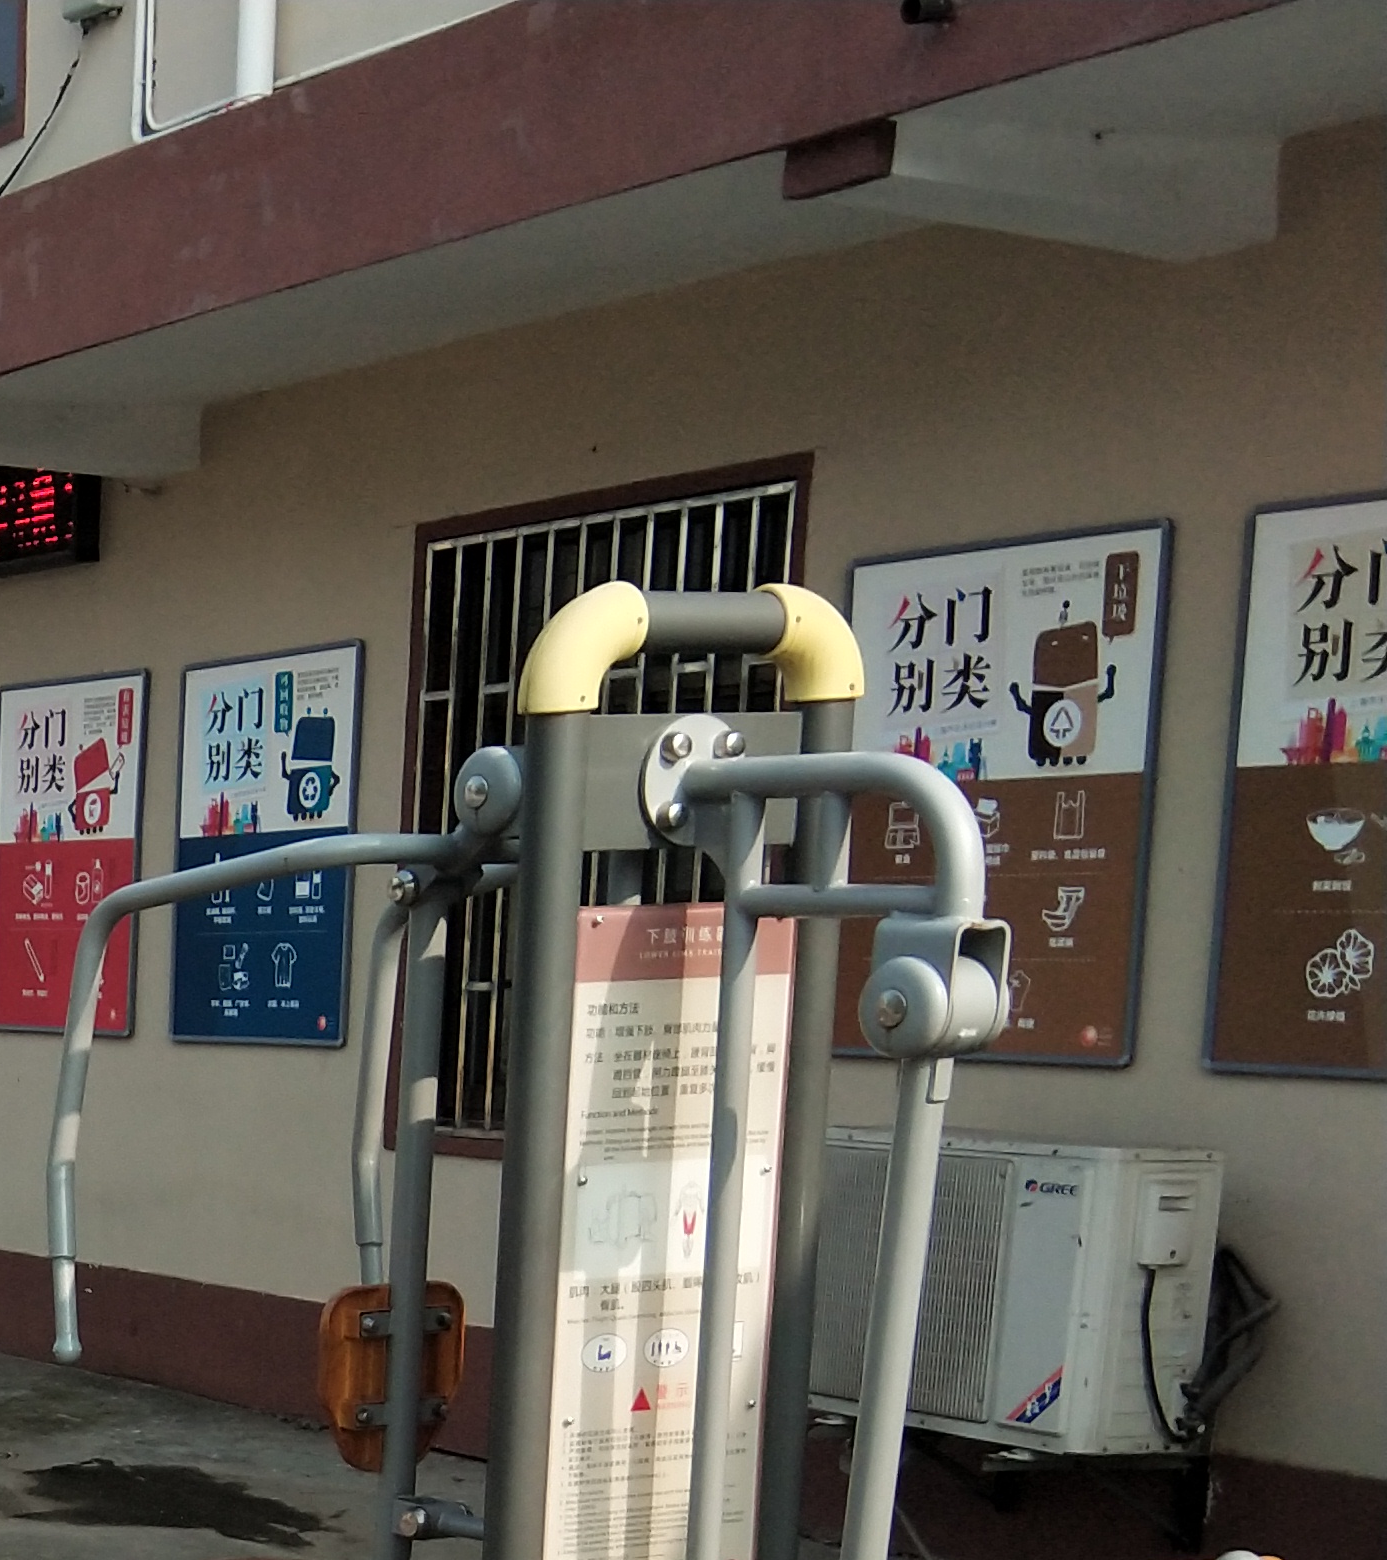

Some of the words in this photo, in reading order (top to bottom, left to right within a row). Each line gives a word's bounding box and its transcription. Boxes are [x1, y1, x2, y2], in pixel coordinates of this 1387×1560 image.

[889, 586, 992, 653] 分门
[888, 653, 993, 717] 别类
[18, 708, 66, 751] 分门
[205, 687, 264, 735] 分门
[17, 754, 66, 794] 别类
[205, 736, 264, 784] 别类
[1039, 1182, 1079, 1197] GREE
